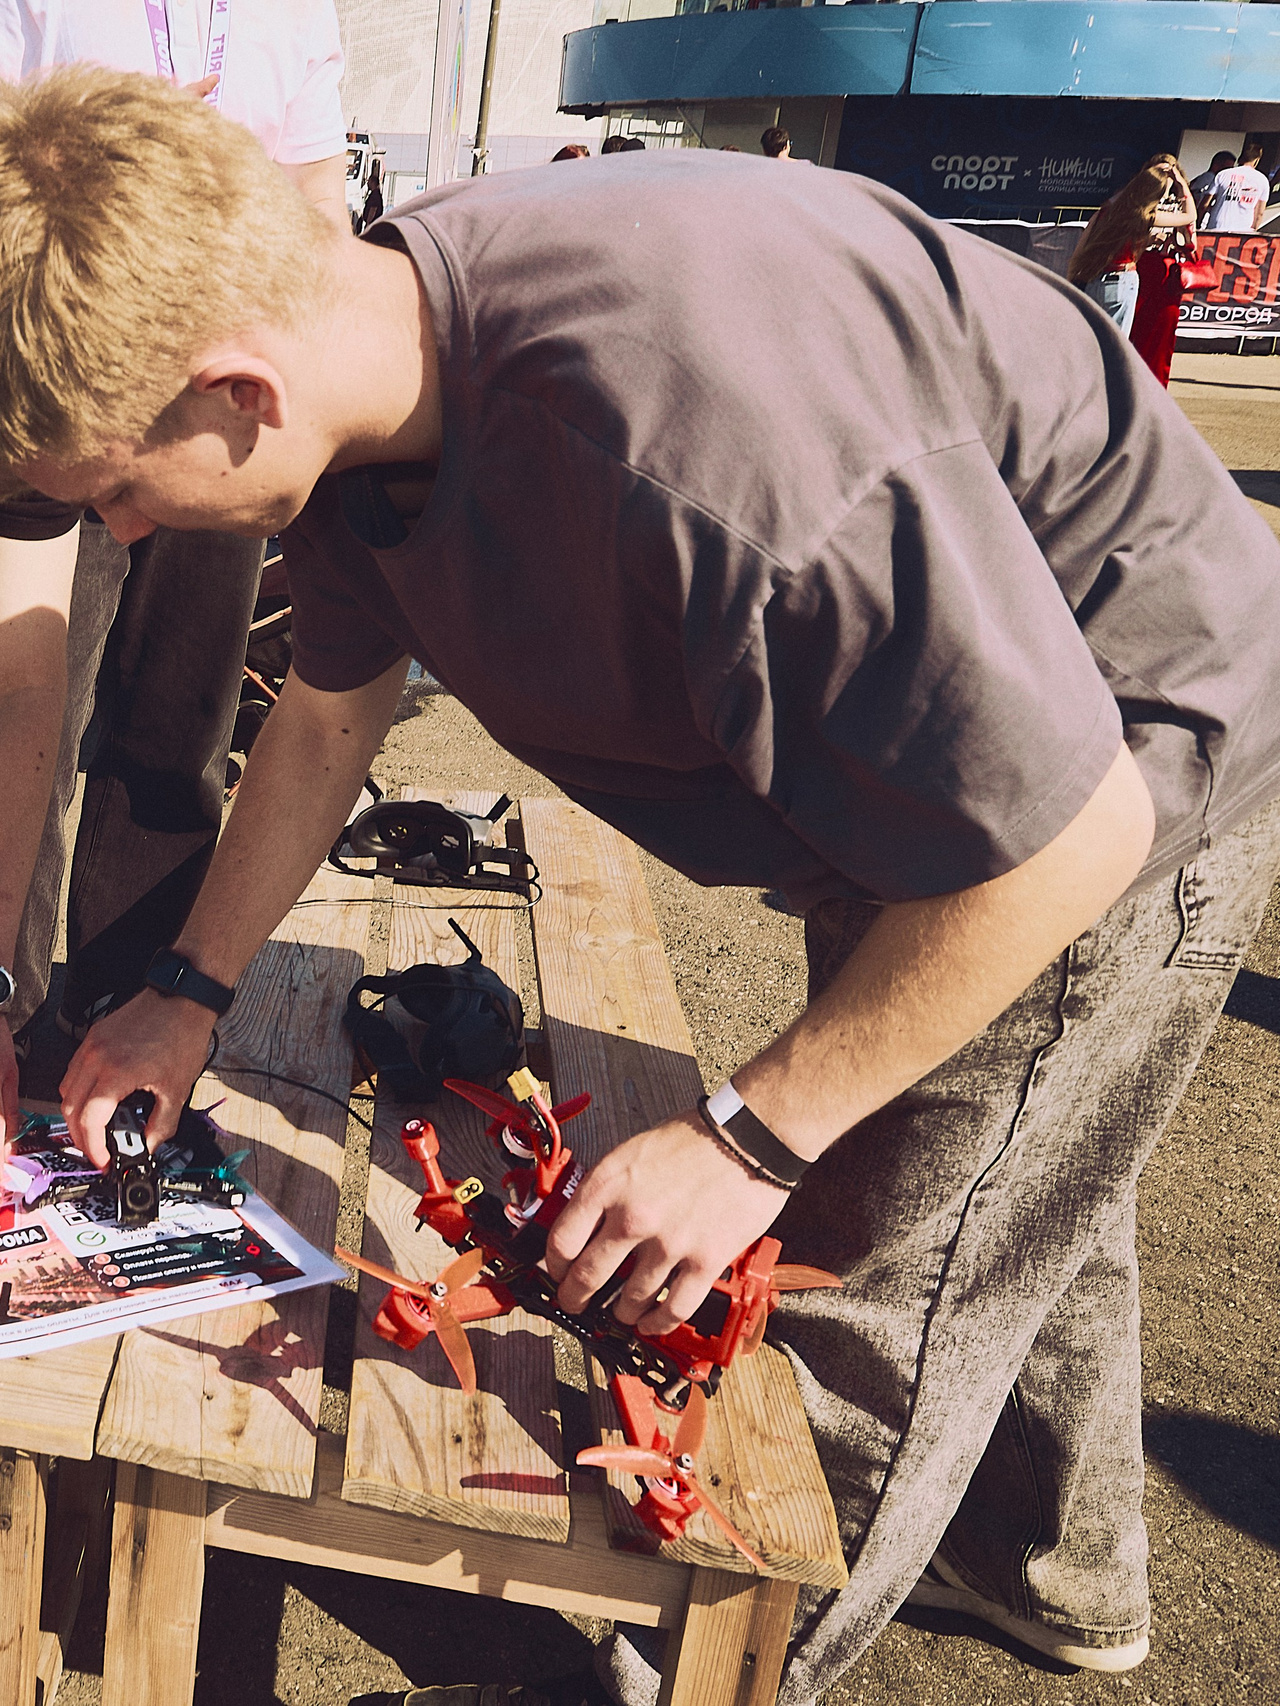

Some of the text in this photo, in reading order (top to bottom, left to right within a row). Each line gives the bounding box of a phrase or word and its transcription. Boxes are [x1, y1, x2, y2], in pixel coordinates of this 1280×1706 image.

[1038, 185, 1110, 194] СТОЛИЦА РОССИИ
[1178, 305, 1272, 325] ОВГОРОД
